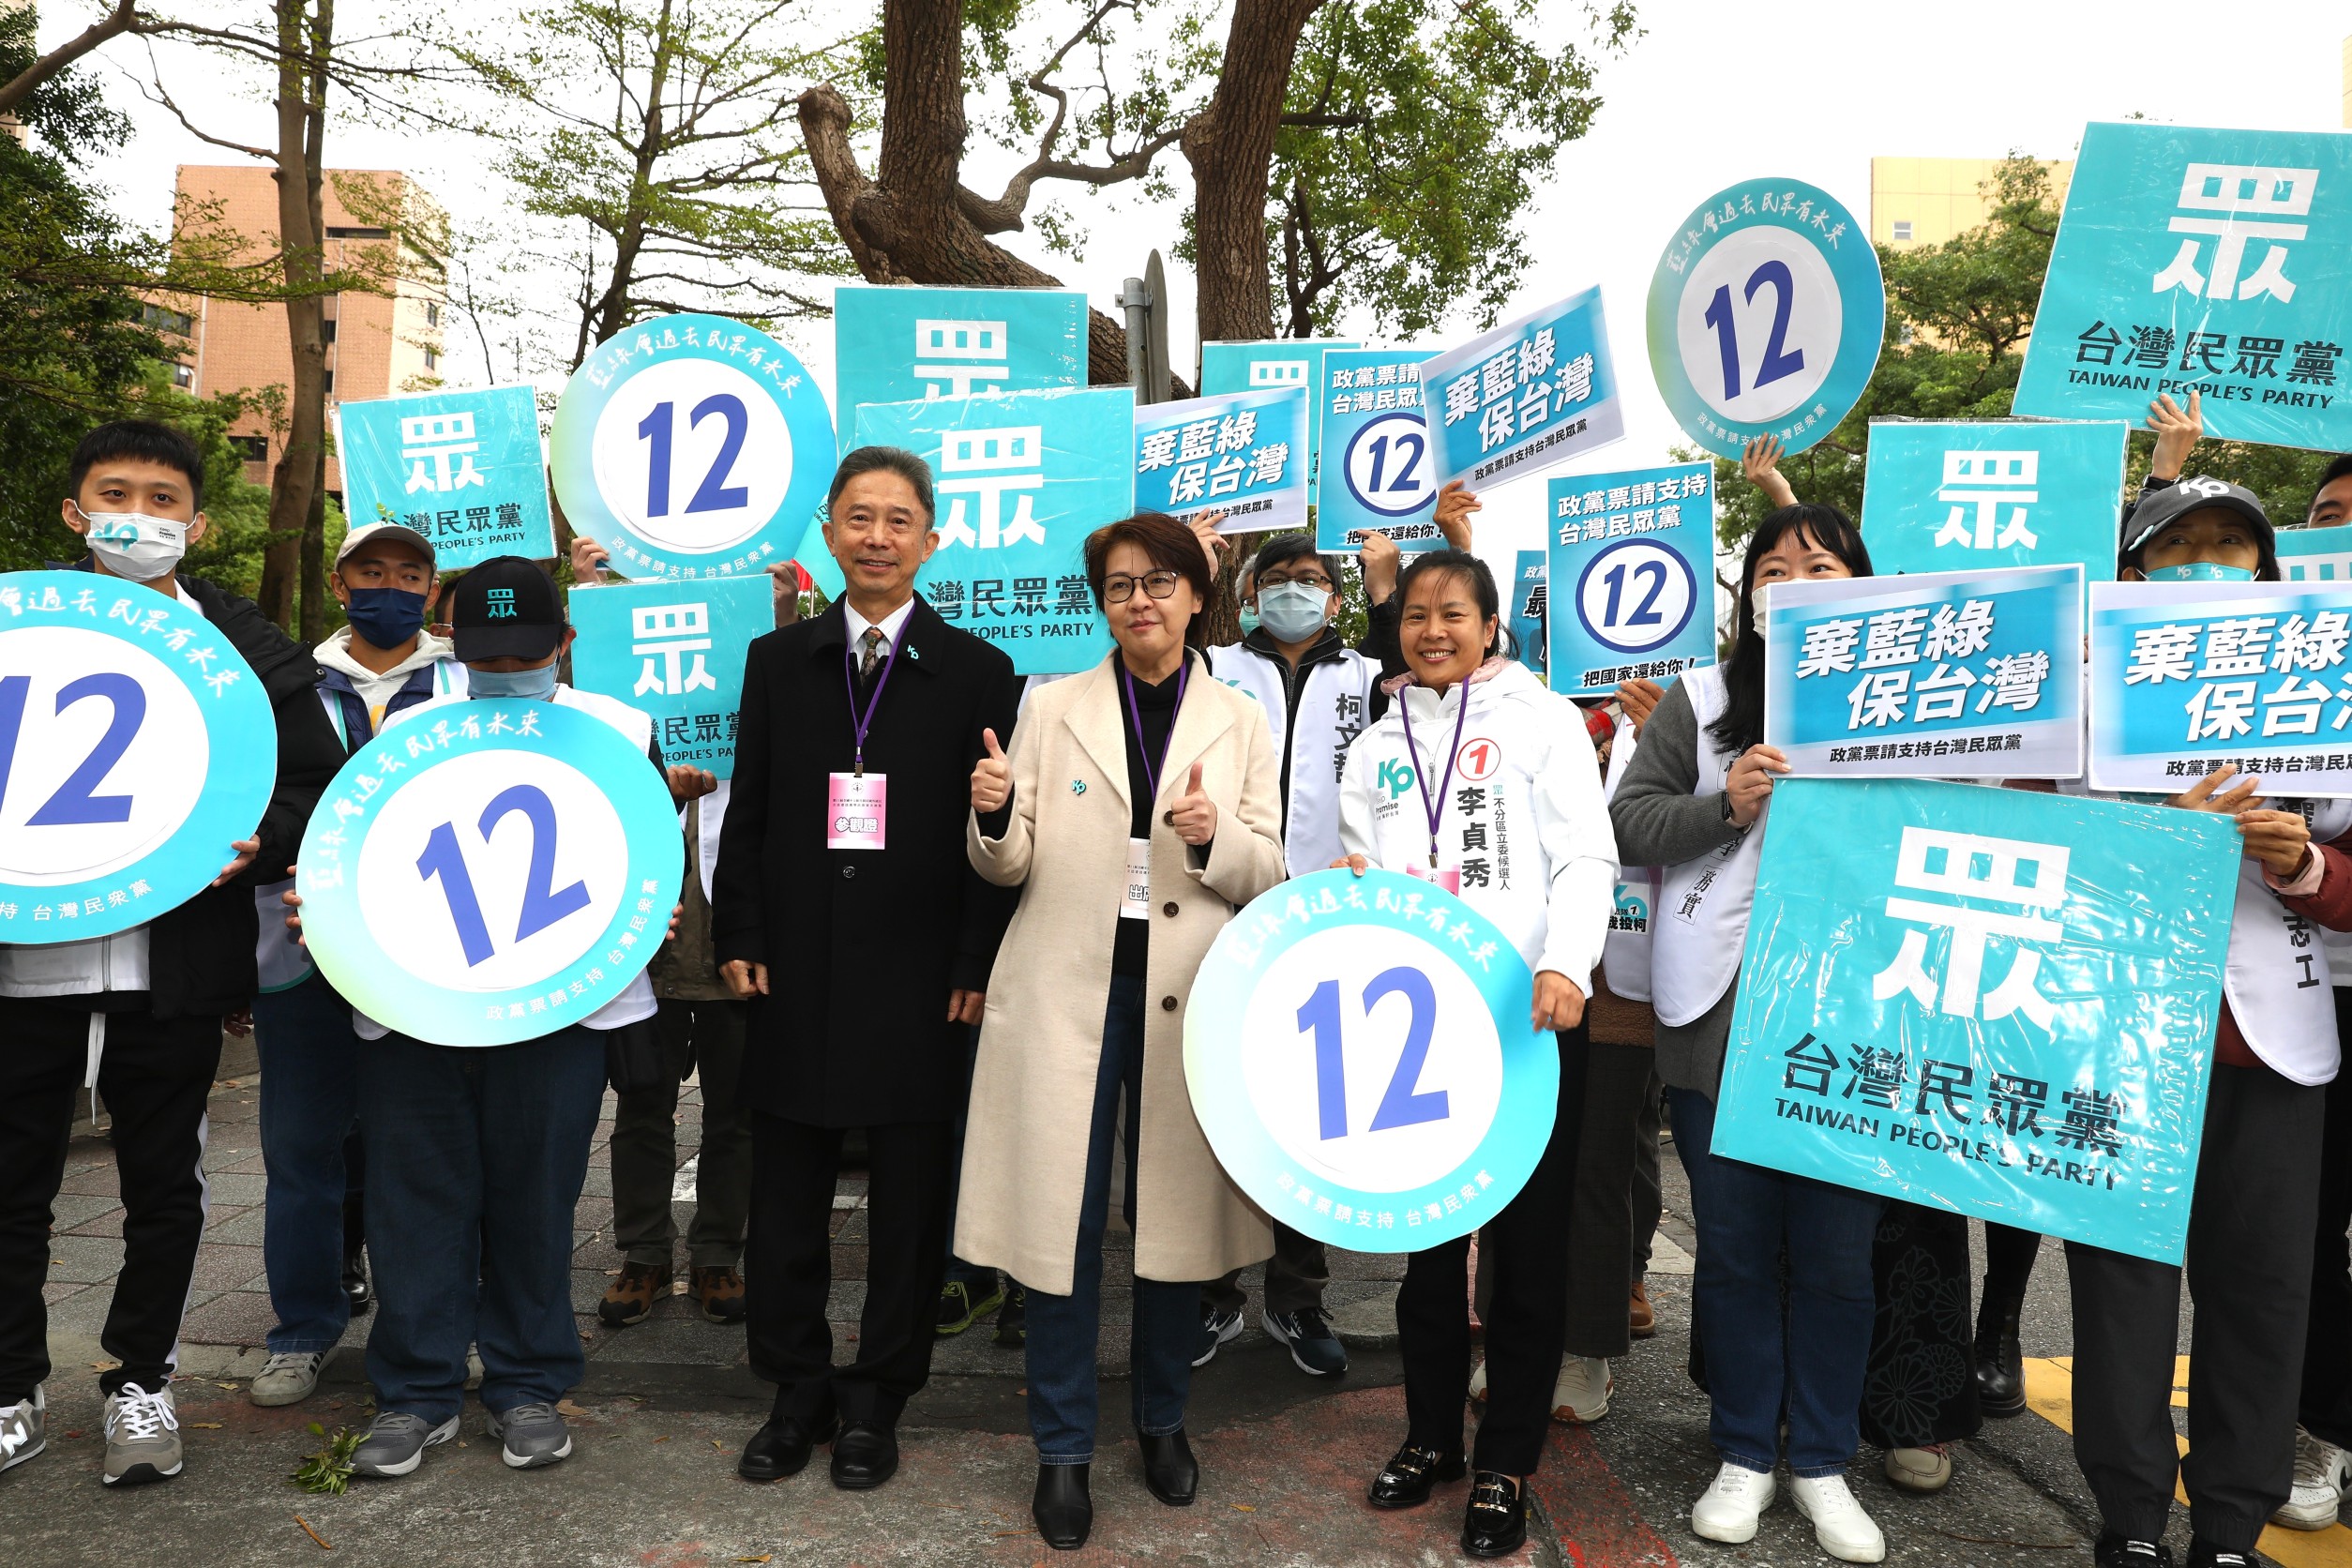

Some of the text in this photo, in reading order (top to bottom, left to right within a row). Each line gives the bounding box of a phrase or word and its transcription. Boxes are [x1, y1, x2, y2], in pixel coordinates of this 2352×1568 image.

[2152, 162, 2320, 304] 眾
[1705, 260, 1804, 401] 12
[2074, 320, 2344, 386] 台灣民眾黨
[1332, 386, 1425, 415] 台灣民眾
[1444, 327, 1557, 428] 棄藍綠
[1478, 352, 1594, 454] 保台灣
[2068, 369, 2334, 409] TAIWAN PEOPLE'S PARTY
[400, 412, 484, 494] 眾
[639, 393, 748, 518] 12
[1138, 411, 1257, 474] 棄藍綠
[1168, 442, 1289, 505] 保台灣
[1368, 432, 1425, 492] 12
[1474, 418, 1588, 481] 政黨票請支持台灣民眾黨
[381, 503, 523, 537] 灣民眾黨
[937, 425, 1047, 550] 眾
[1558, 472, 1709, 519] 政黨票請支持
[1934, 450, 2040, 550] 眾
[490, 532, 526, 544] PARTY
[611, 535, 697, 579] 政黨票請支持
[1559, 505, 1682, 547] 台灣民眾黨
[487, 588, 517, 618] 眾
[1603, 560, 1667, 627] 12
[632, 602, 716, 697] 眾
[1041, 623, 1094, 637] PARTY
[1796, 599, 1995, 680] 棄藍綠
[2123, 611, 2351, 686] 棄藍綠
[1847, 650, 2049, 731] 保台灣
[1830, 733, 2022, 762] 政黨票請支持台灣民眾黨
[2166, 753, 2352, 776] 政黨票請支持台灣民
[1456, 787, 1491, 888] 李貞秀
[1493, 797, 1511, 891] 不分區立委候選人
[415, 784, 591, 968] 12
[1873, 825, 2071, 1033] 眾
[485, 966, 605, 1020] 政黨票請支持
[1296, 966, 1450, 1140] 12
[1783, 1032, 2127, 1158] 台灣民眾黨
[1775, 1097, 2122, 1192] TAIWAN PEOPLE'S PARTY
[1276, 1171, 1395, 1229] 政黨票請支持
